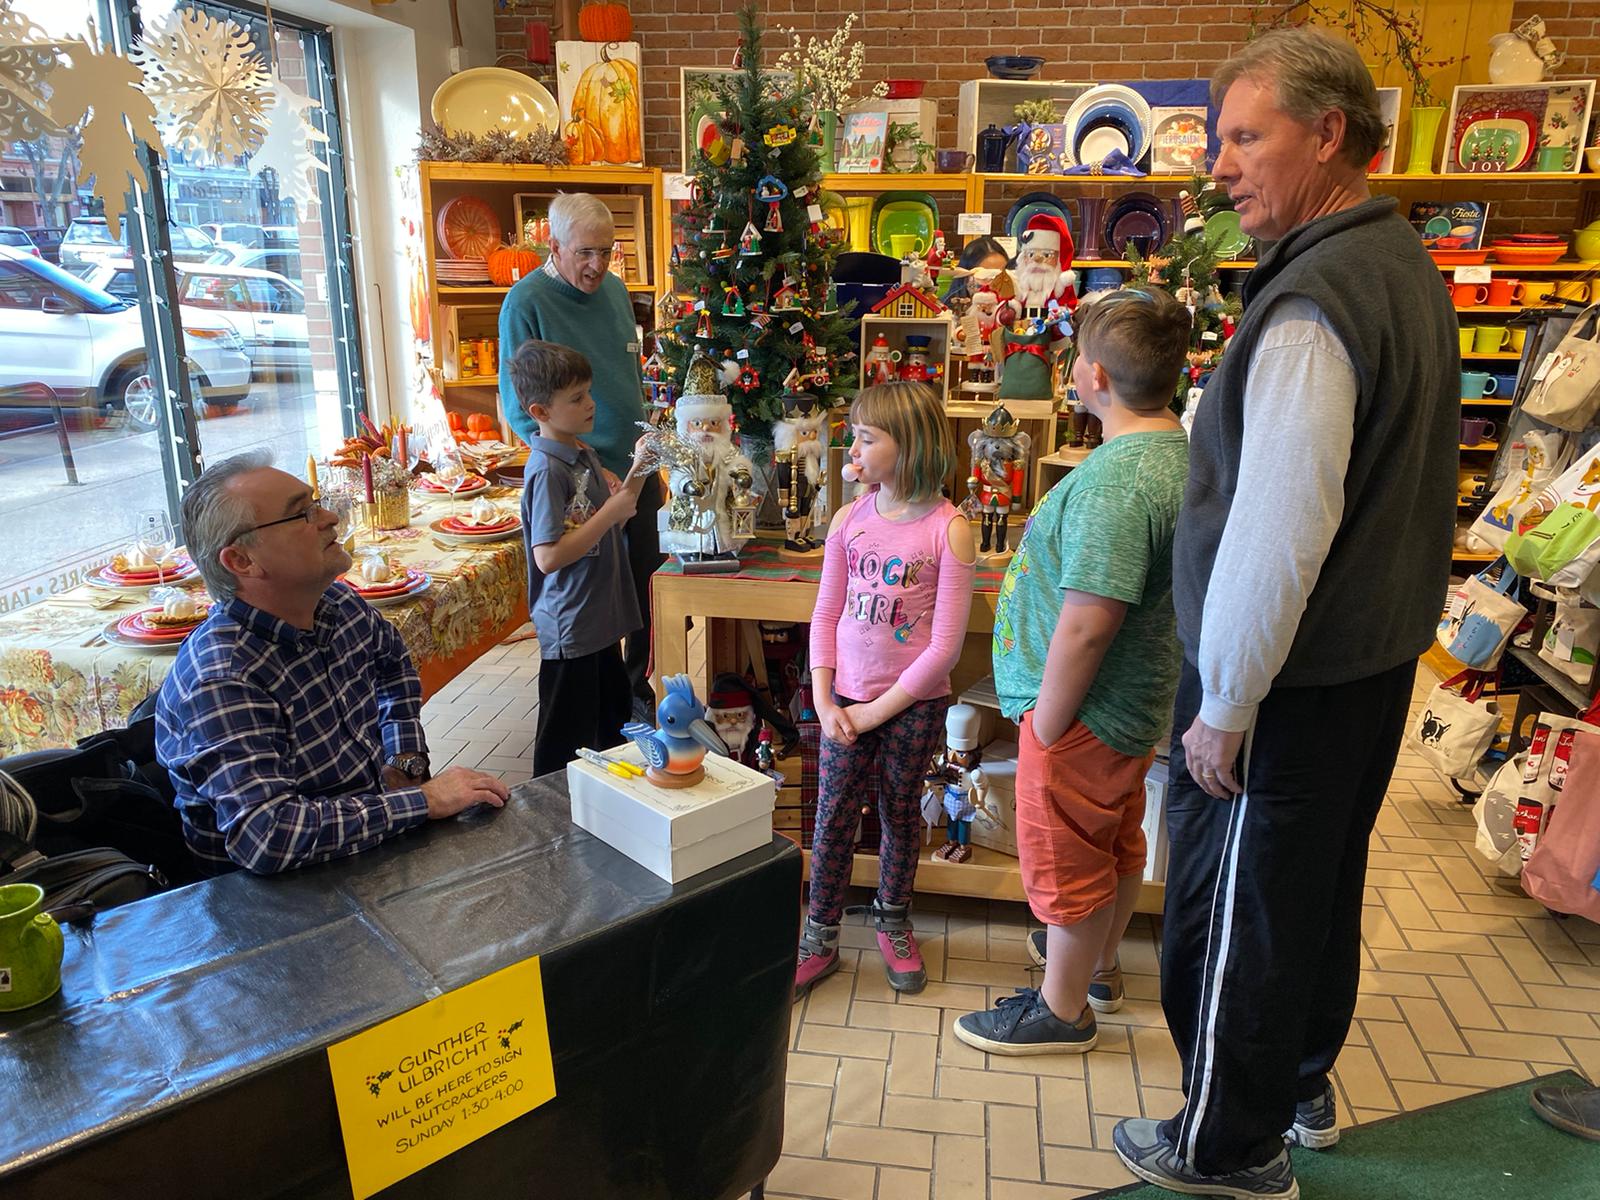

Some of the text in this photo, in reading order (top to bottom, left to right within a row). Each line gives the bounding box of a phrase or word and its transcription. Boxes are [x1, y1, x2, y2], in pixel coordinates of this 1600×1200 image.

[1469, 161, 1505, 172] JOY
[848, 547, 924, 589] ROCK
[398, 1021, 488, 1074] GUNTHER
[398, 1037, 490, 1094] ULBRICHT
[376, 1047, 523, 1129] WILL BE HERE TO SIGN
[395, 1079, 524, 1154] SUNDAY 1:30-4:00
[410, 1071, 509, 1129] NUTCRACKERS
